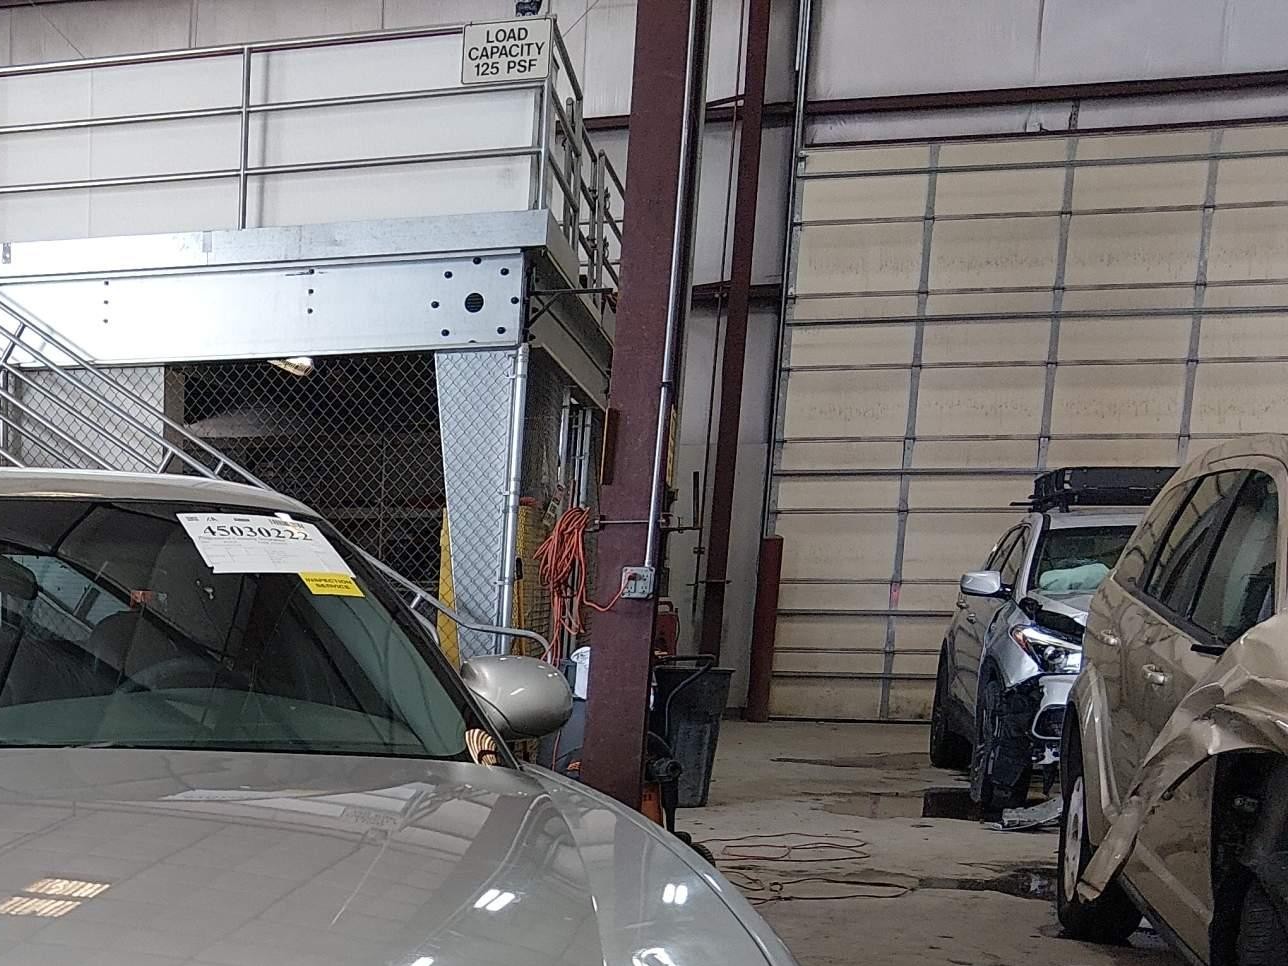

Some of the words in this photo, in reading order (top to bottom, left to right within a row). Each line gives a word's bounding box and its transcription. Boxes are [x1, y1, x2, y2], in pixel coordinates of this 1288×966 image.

[486, 27, 528, 43] LOAD
[468, 41, 545, 61] CAPACITY
[474, 61, 500, 77] 125
[506, 58, 538, 74] PSF
[203, 525, 312, 541] 45030222
[305, 577, 353, 585] INSPECTION
